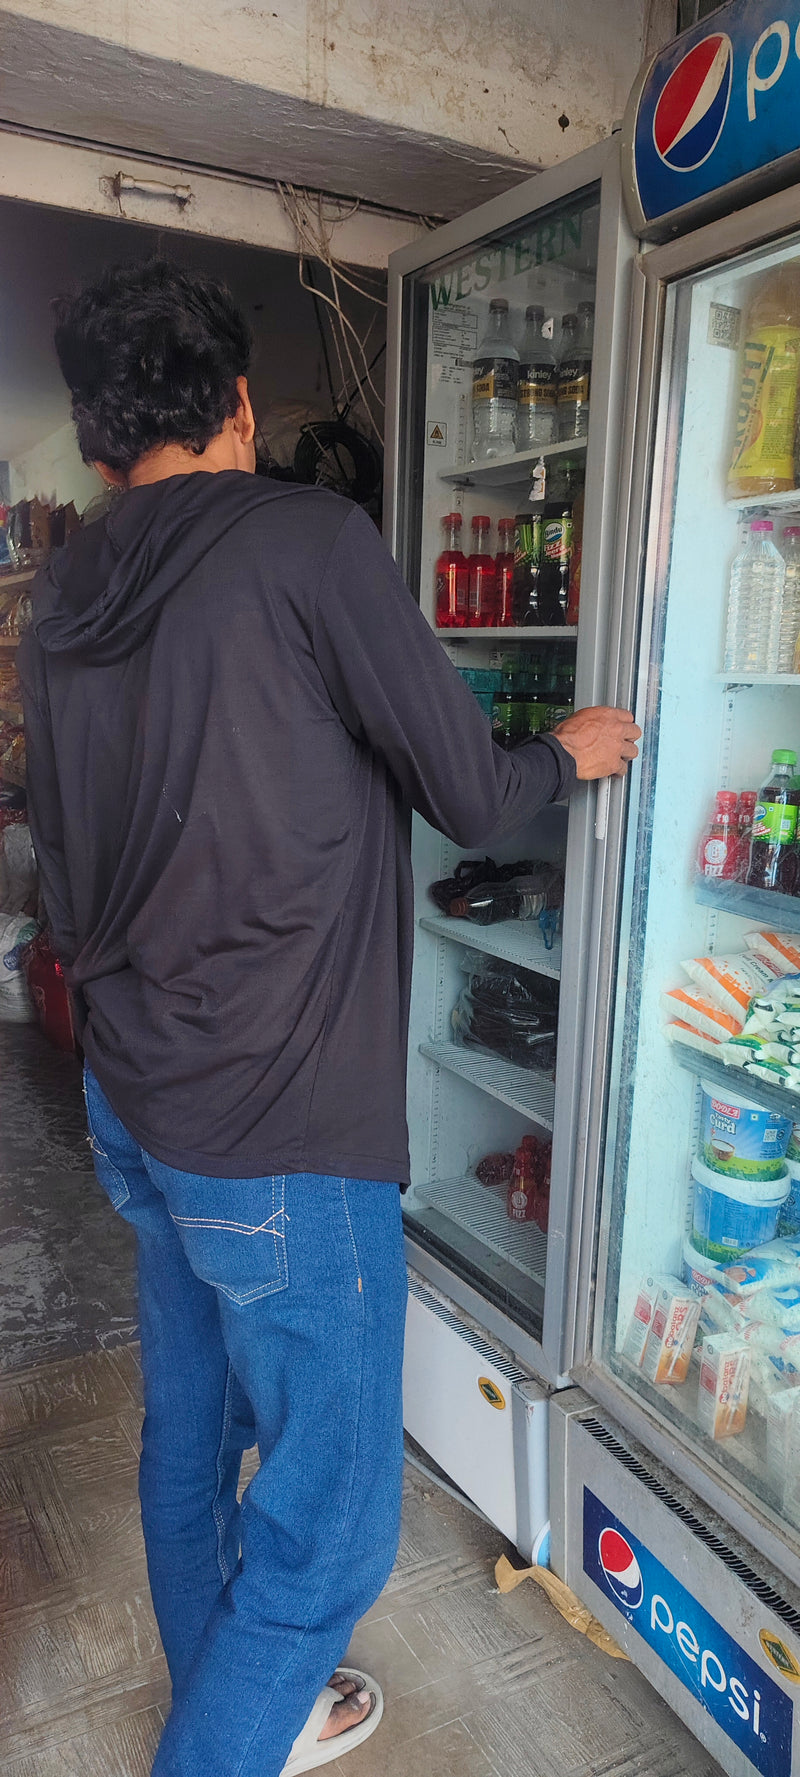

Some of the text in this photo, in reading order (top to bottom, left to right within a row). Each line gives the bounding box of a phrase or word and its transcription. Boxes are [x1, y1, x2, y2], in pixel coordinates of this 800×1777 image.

[430, 211, 583, 311] WESTERN
[527, 369, 551, 381] kinley
[705, 864, 725, 878] FIZZ
[711, 1100, 739, 1118] DODLA
[710, 1114, 736, 1135] Curd
[651, 1594, 762, 1737] pepsi
